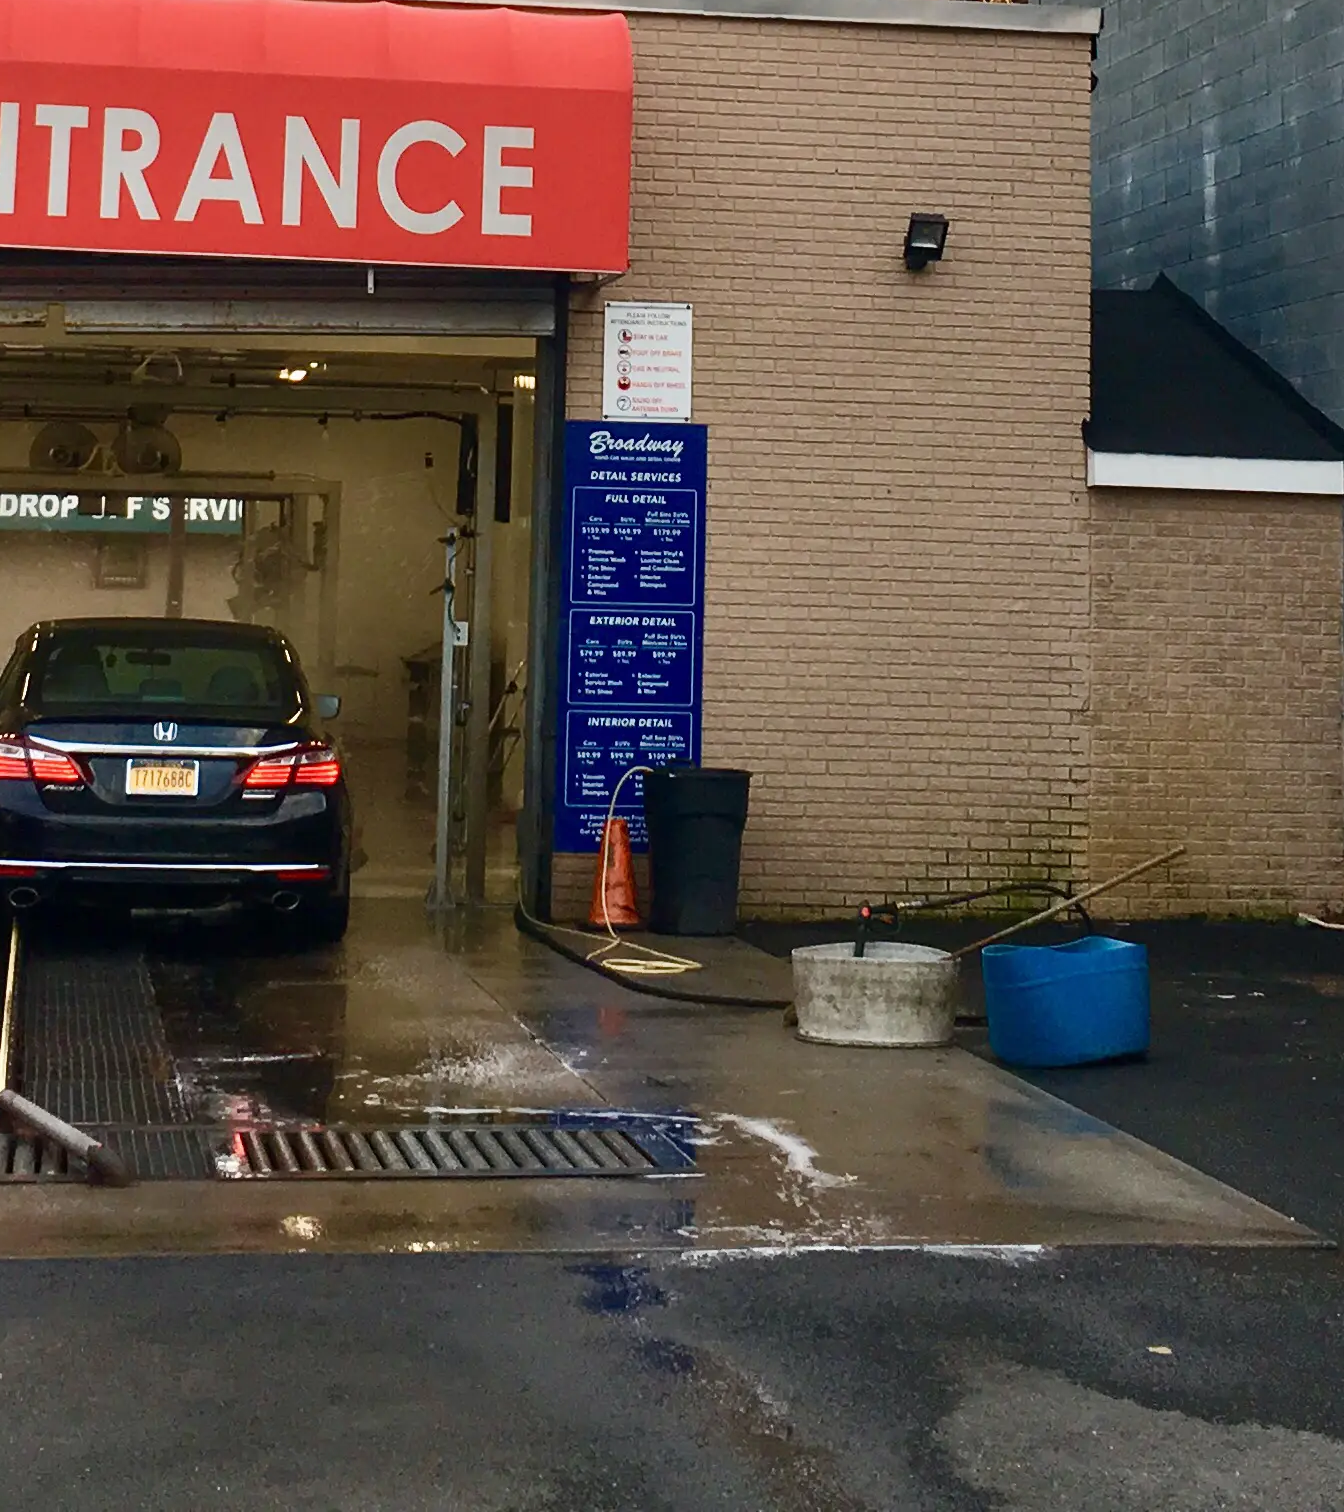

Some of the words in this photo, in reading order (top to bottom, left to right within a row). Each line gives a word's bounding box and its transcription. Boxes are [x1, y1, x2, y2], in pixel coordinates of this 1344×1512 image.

[589, 431, 684, 458] Broadway
[591, 471, 627, 481] DETAIL
[630, 472, 681, 482] SERVICES
[605, 494, 629, 503] FULL
[633, 495, 666, 504] DETAIL
[152, 497, 242, 521] SRVI
[590, 616, 639, 625] EXTERIOR
[642, 617, 676, 626] DETAIL
[588, 718, 636, 726] INTERIOR
[638, 719, 672, 727] DETAIL
